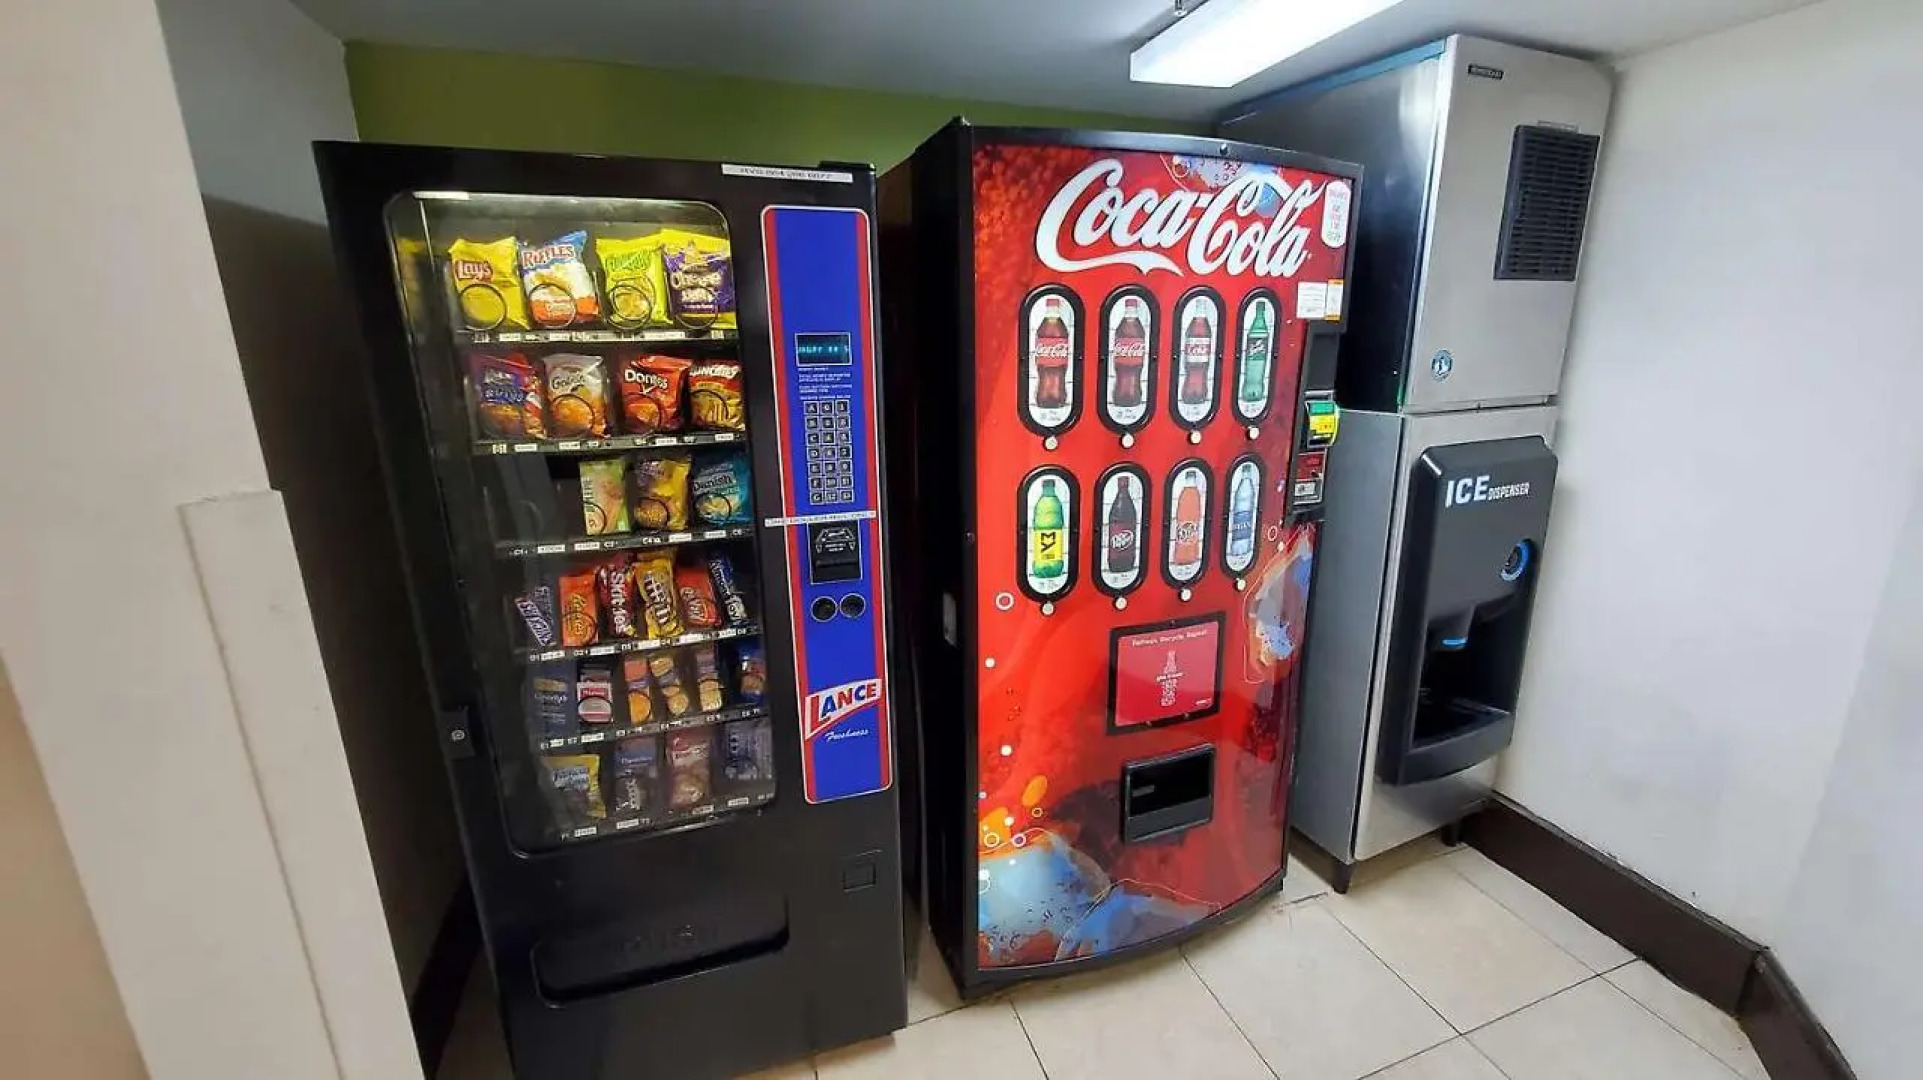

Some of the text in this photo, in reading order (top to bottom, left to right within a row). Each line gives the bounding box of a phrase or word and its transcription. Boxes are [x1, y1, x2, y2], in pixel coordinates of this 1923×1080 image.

[1035, 158, 1326, 278] Coca-Cola
[1445, 475, 1530, 508] ICE DISPENSER
[810, 682, 877, 732] LANCE
